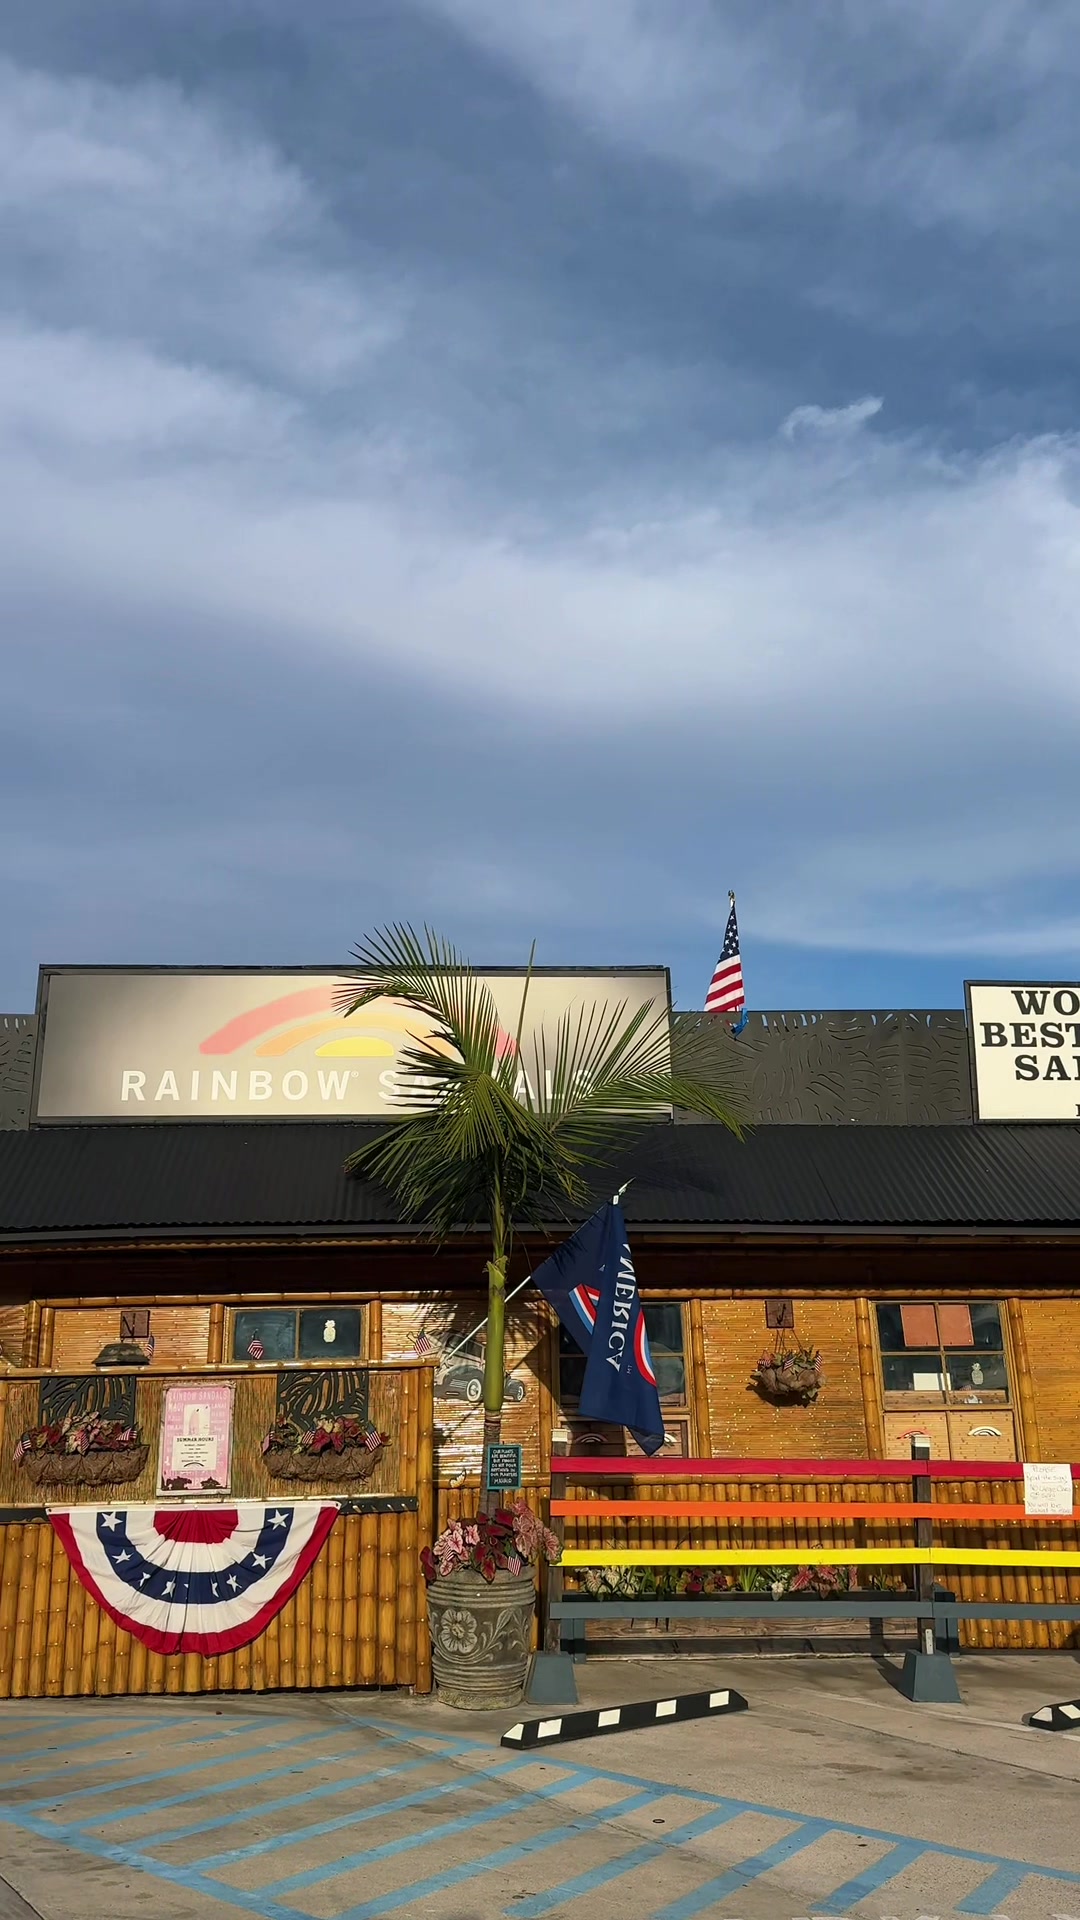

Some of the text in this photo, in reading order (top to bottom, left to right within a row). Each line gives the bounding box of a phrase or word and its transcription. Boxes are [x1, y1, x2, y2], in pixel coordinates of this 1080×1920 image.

[980, 1022, 1080, 1048] BEST
[1014, 1054, 1080, 1081] SA
[199, 1390, 228, 1400] SANDALS
